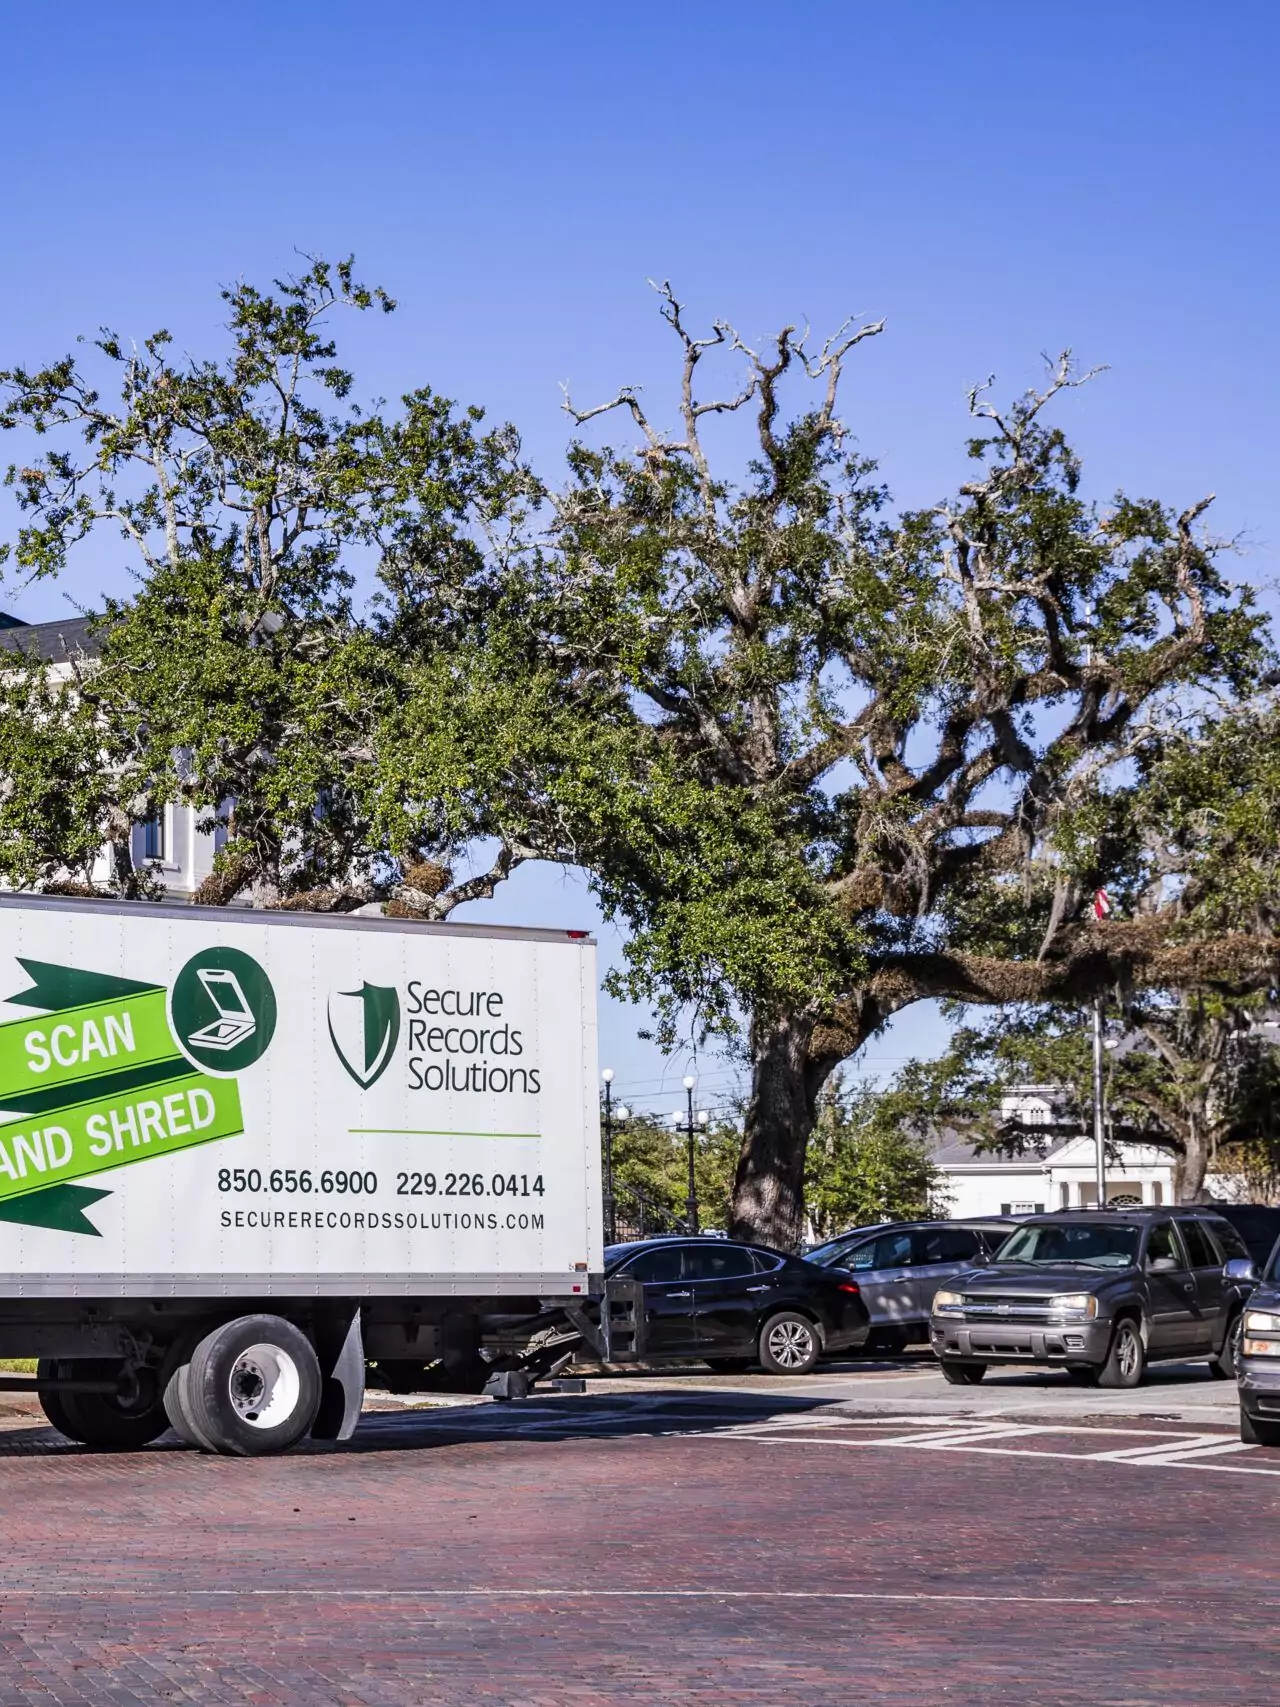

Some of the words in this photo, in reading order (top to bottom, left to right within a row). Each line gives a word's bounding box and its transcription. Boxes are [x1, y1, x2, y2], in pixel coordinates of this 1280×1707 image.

[407, 980, 504, 1017] Secure
[24, 1011, 137, 1073] SCAN
[408, 1019, 524, 1056] Records
[407, 1057, 541, 1094] Solutions
[85, 1088, 216, 1157] SHRED
[217, 1168, 378, 1194] 850.656.6900
[396, 1172, 546, 1197] 229.226.0414
[220, 1211, 545, 1230] SECURERECORDSSOLUTIONS.COM
